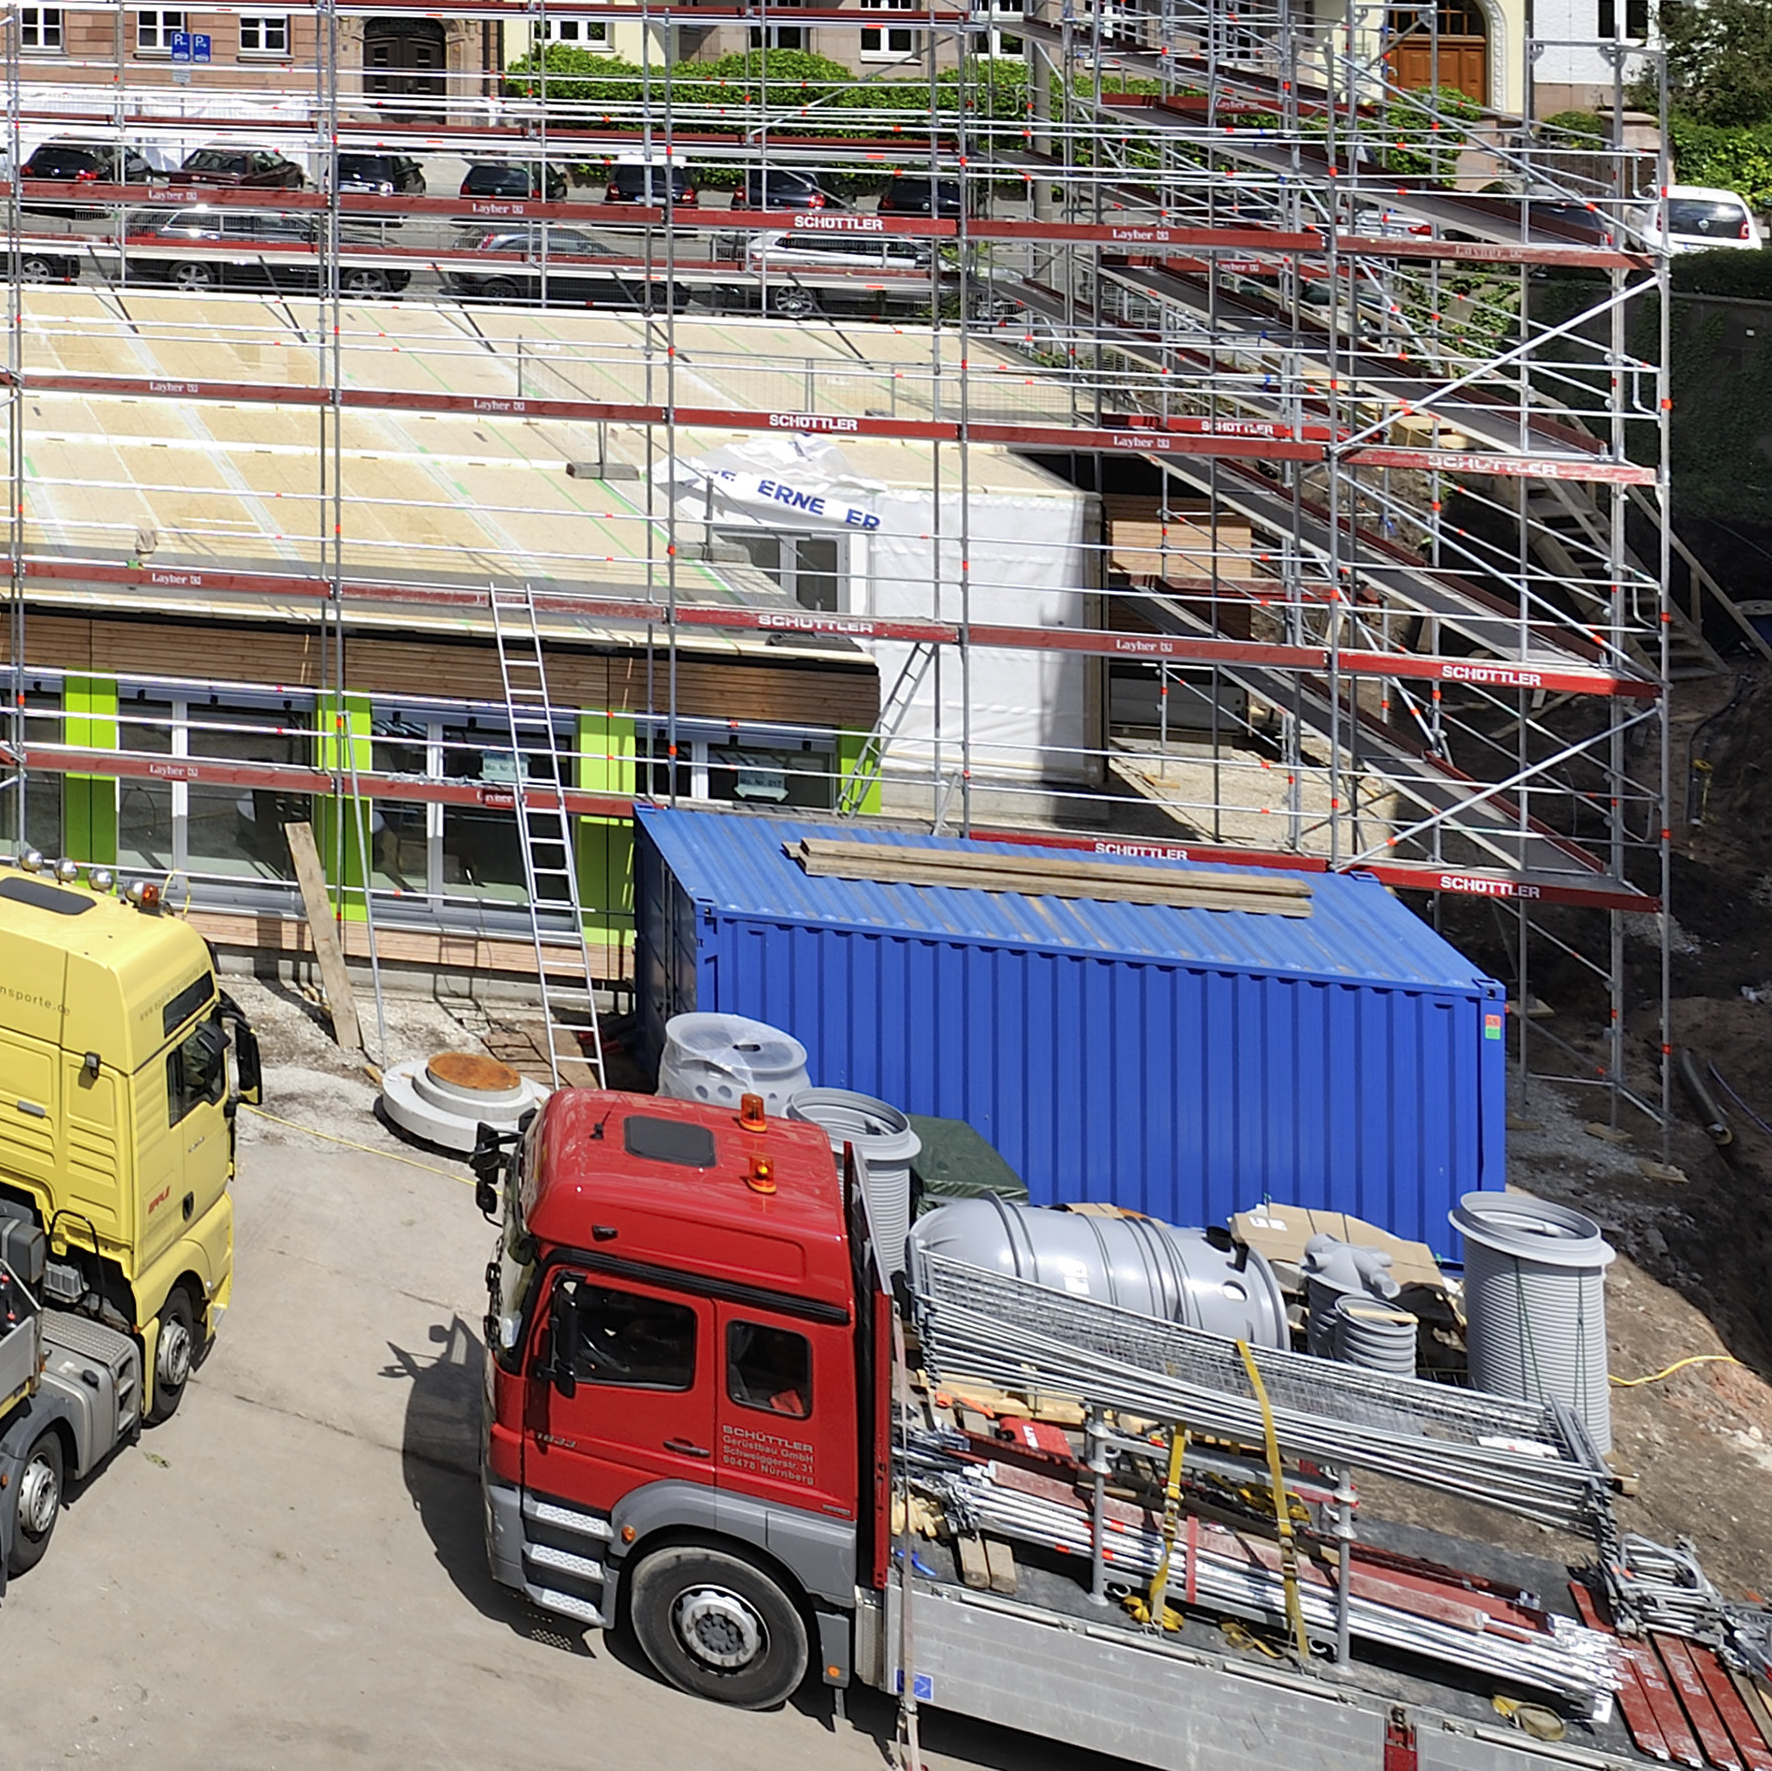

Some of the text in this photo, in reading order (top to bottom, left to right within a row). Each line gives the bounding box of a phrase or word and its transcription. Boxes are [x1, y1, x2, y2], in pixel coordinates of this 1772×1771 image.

[148, 188, 183, 201] Layher
[473, 203, 509, 215] Layher
[1113, 227, 1154, 242] Layher
[149, 381, 184, 394] Layher
[473, 399, 510, 411] Layher
[1113, 435, 1154, 449] Layher
[757, 480, 826, 515] ERNE
[845, 508, 881, 528] ER
[152, 572, 187, 584] Layher
[1116, 639, 1157, 653] Layher
[149, 764, 184, 777] Layher
[723, 1425, 813, 1453] SCHÜTTLER
[780, 1447, 814, 1464] GmbH
